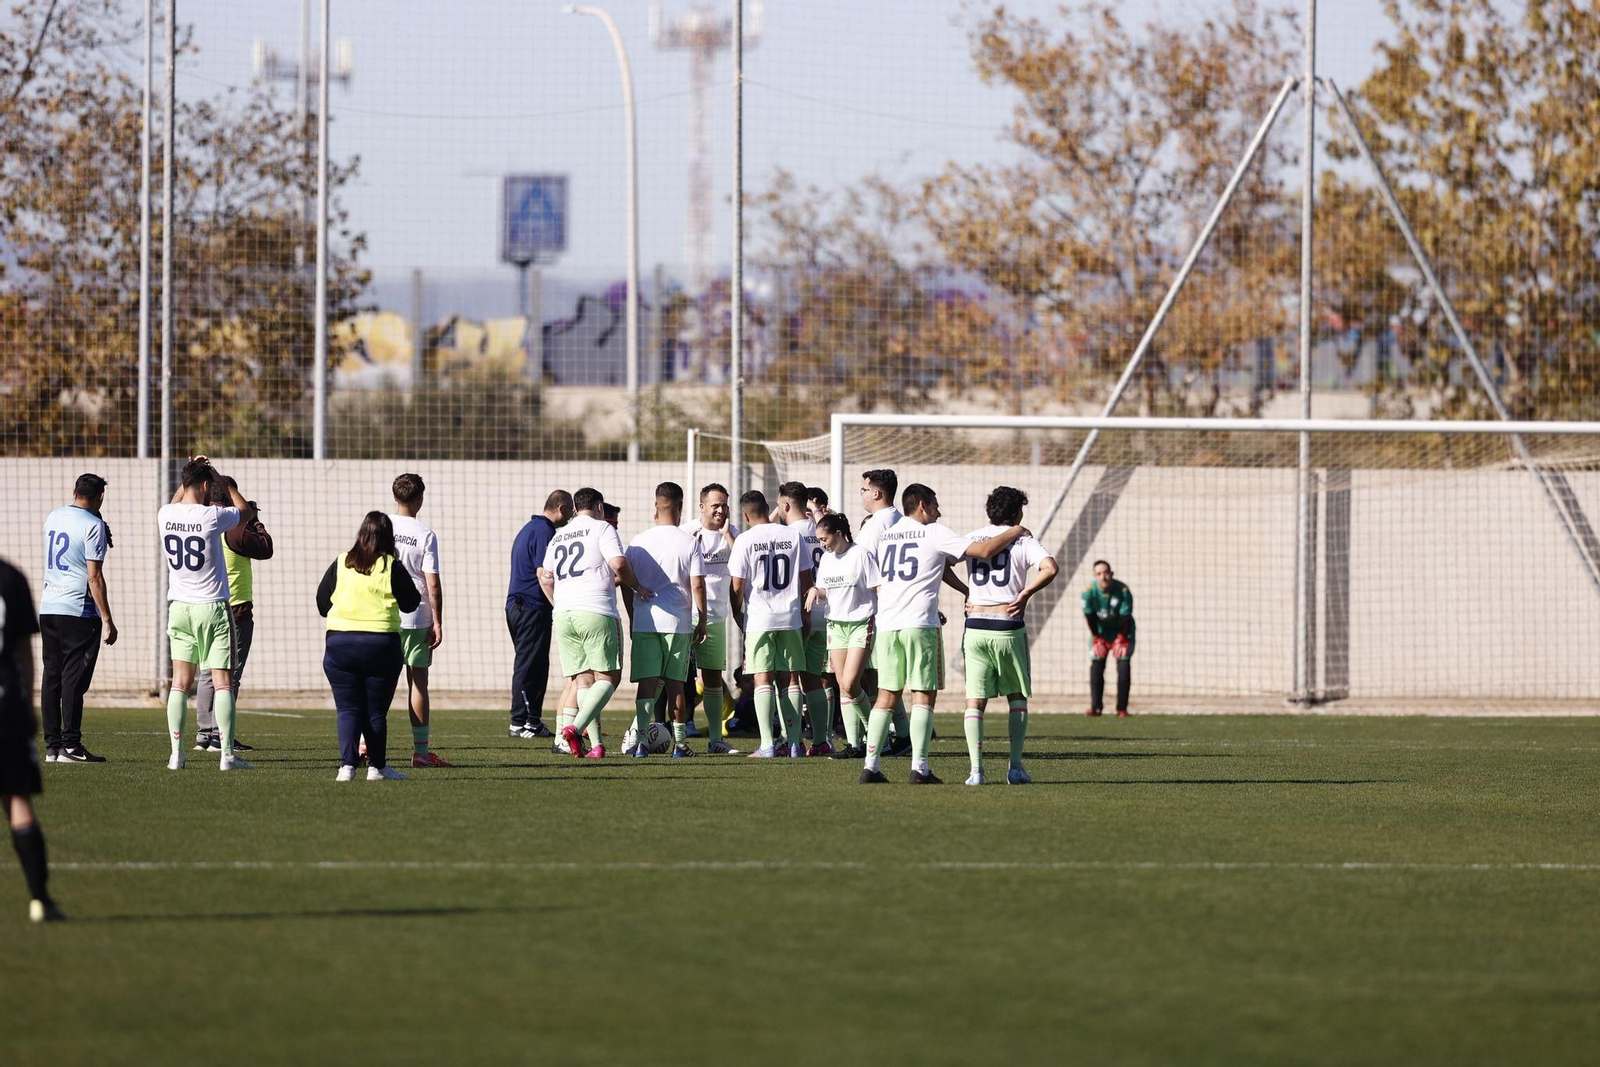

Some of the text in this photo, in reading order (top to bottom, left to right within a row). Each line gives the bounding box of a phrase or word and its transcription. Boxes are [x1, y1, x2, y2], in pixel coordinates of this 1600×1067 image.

[165, 521, 202, 532] CARLIYO
[563, 529, 590, 541] CHARLY
[48, 530, 69, 571] 12
[164, 534, 205, 571] 98
[554, 541, 584, 581] 22
[881, 542, 919, 582] 45
[971, 549, 1011, 587] 69
[759, 553, 790, 590] 10
